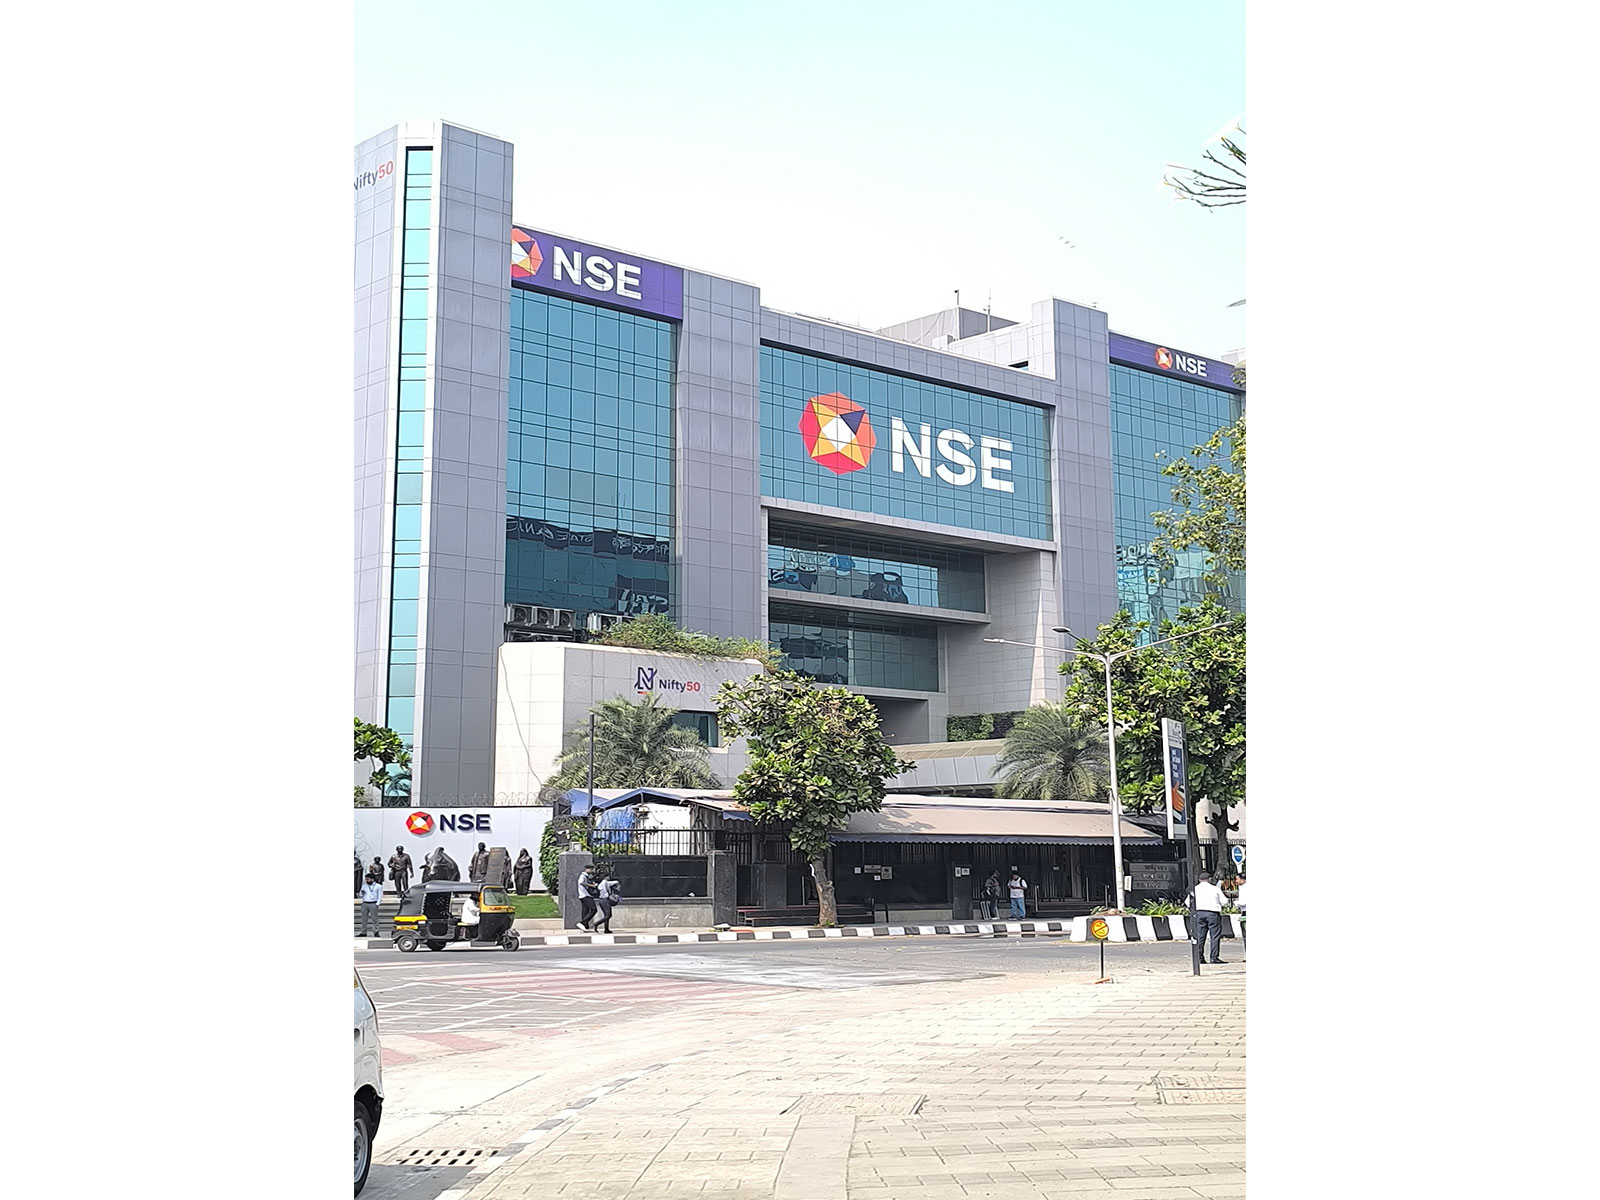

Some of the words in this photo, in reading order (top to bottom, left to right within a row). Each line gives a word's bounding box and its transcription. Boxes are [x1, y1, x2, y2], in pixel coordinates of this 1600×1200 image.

[552, 245, 641, 300] NSE
[1175, 354, 1208, 377] NSE
[891, 416, 1015, 493] NSE
[658, 679, 701, 693] Nifty50
[439, 813, 491, 832] NSE
